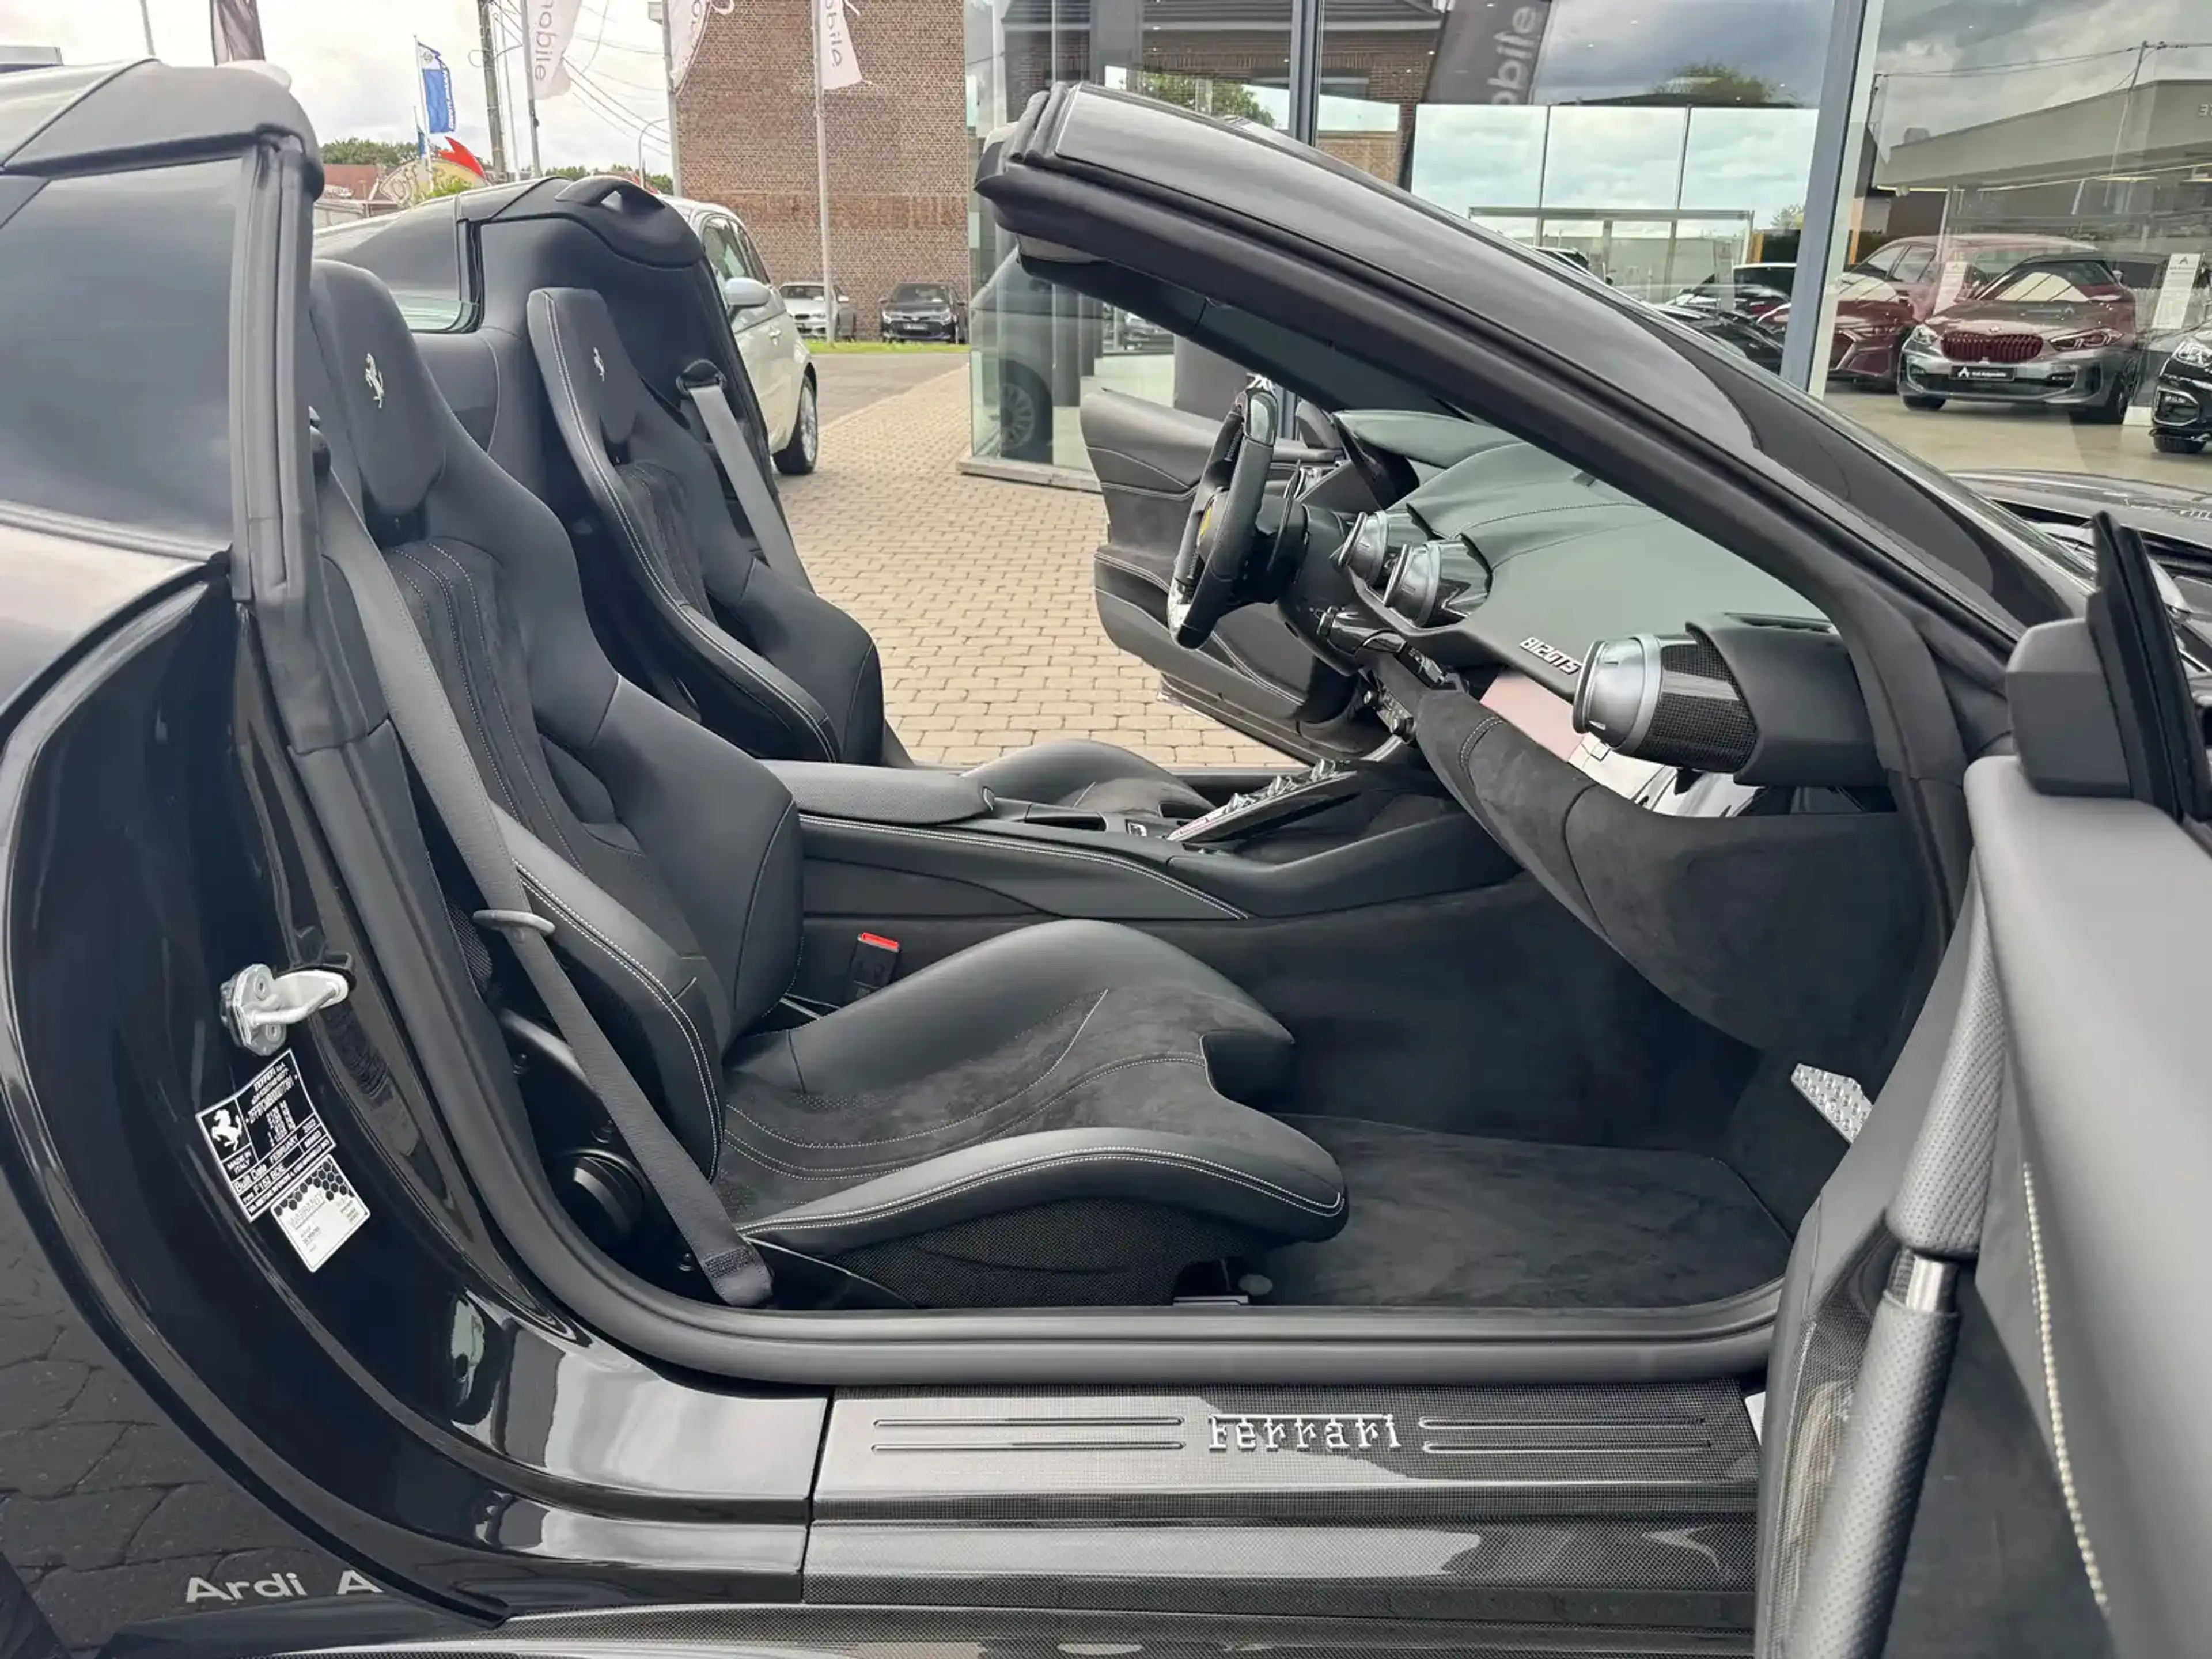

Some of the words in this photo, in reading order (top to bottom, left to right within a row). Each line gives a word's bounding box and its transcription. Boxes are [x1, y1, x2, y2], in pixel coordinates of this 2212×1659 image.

[1207, 1412, 1402, 1450] Ferrari
[185, 1572, 308, 1603] Ardi
[336, 1570, 385, 1595] A
